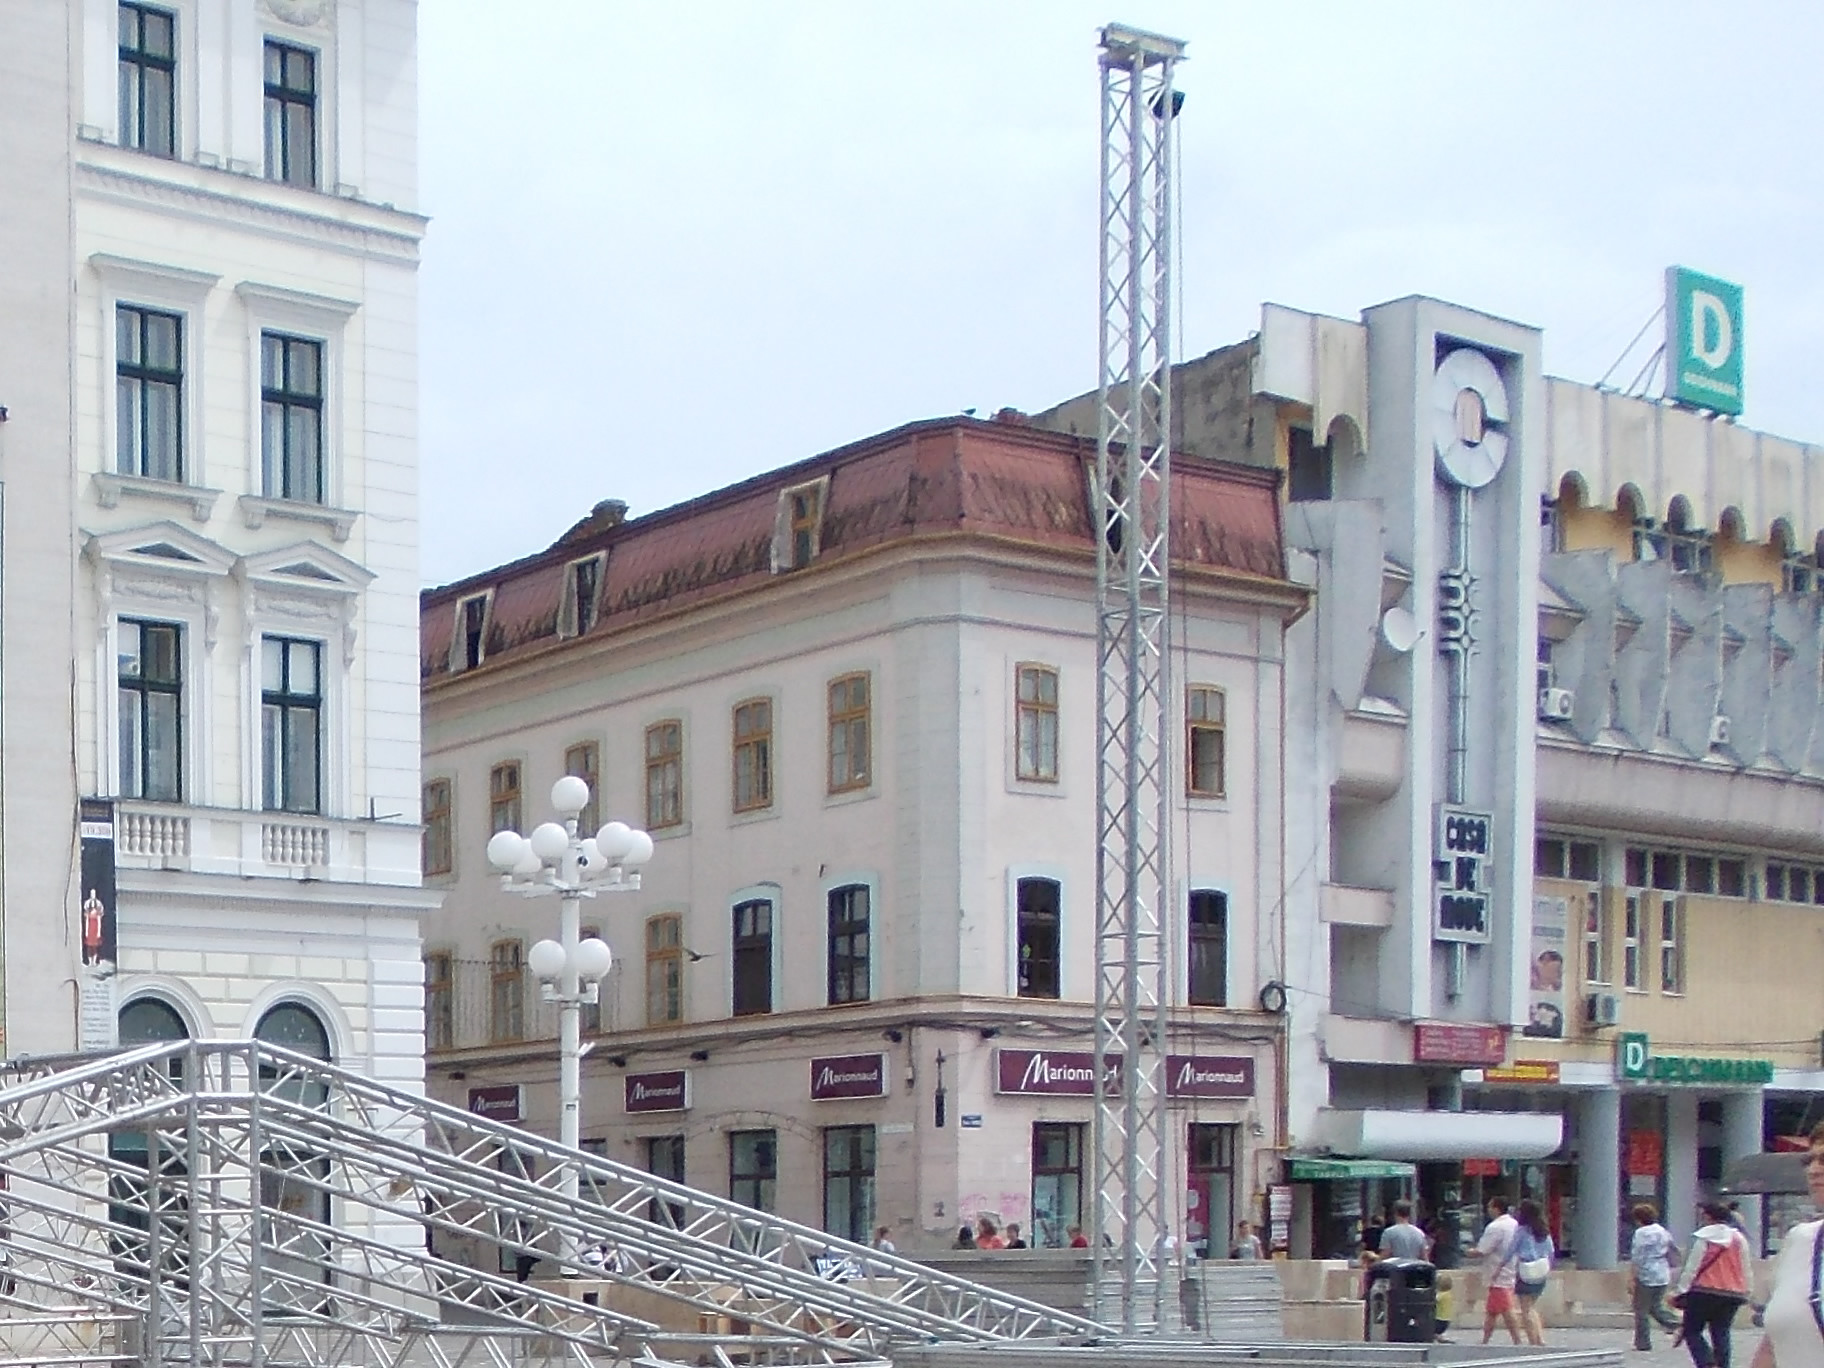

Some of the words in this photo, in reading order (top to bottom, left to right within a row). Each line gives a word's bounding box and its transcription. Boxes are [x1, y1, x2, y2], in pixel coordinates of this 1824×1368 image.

[1692, 289, 1731, 370] D
[1626, 1042, 1643, 1071] D
[815, 1066, 878, 1091] Marionnaud
[1020, 1053, 1117, 1090] Marionnd
[1176, 1061, 1245, 1089] Marionnaud
[629, 1082, 681, 1104] Marionnaud
